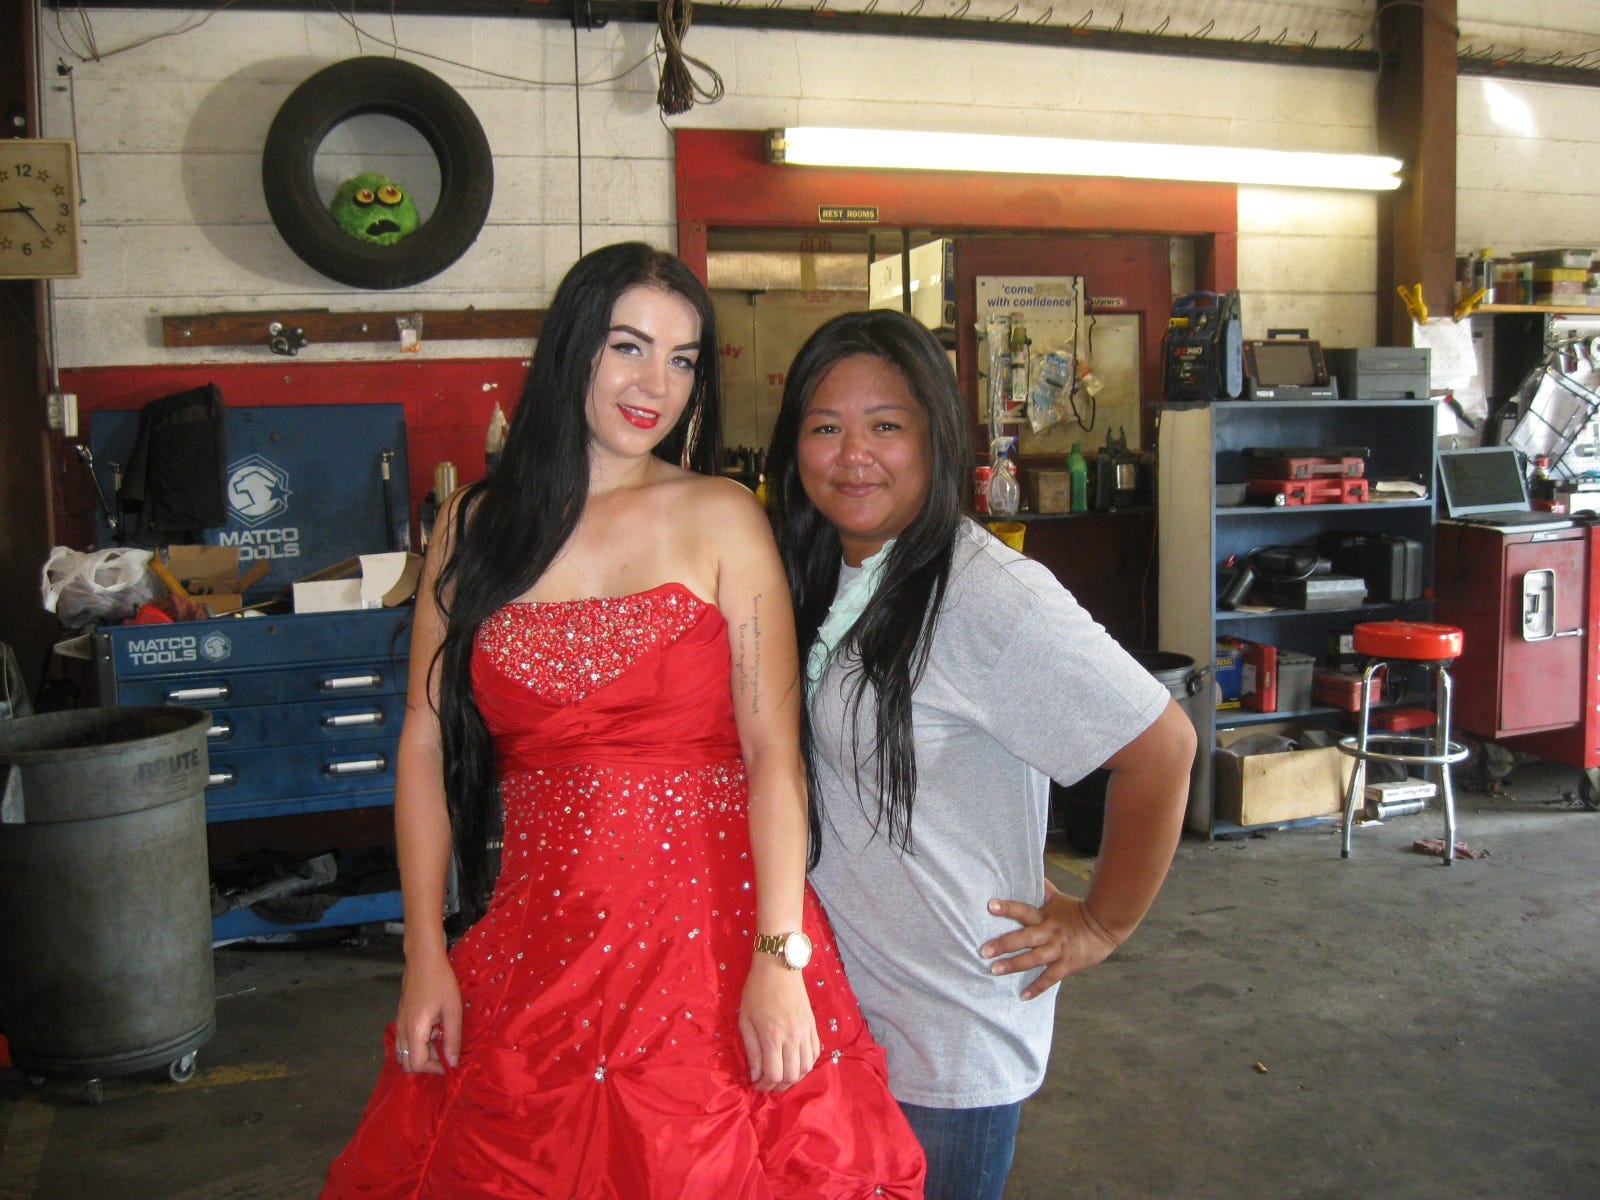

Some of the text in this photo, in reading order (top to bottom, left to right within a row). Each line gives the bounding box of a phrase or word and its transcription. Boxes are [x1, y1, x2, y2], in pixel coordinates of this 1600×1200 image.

[14, 163, 32, 178] 12
[59, 203, 69, 217] 3
[822, 209, 875, 218] REST ROOMS
[22, 242, 33, 257] 6
[987, 297, 1010, 307] with
[219, 527, 299, 546] MATCO
[238, 542, 300, 561] OOLS
[128, 636, 197, 653] MATCO
[129, 649, 197, 666] TOOLS
